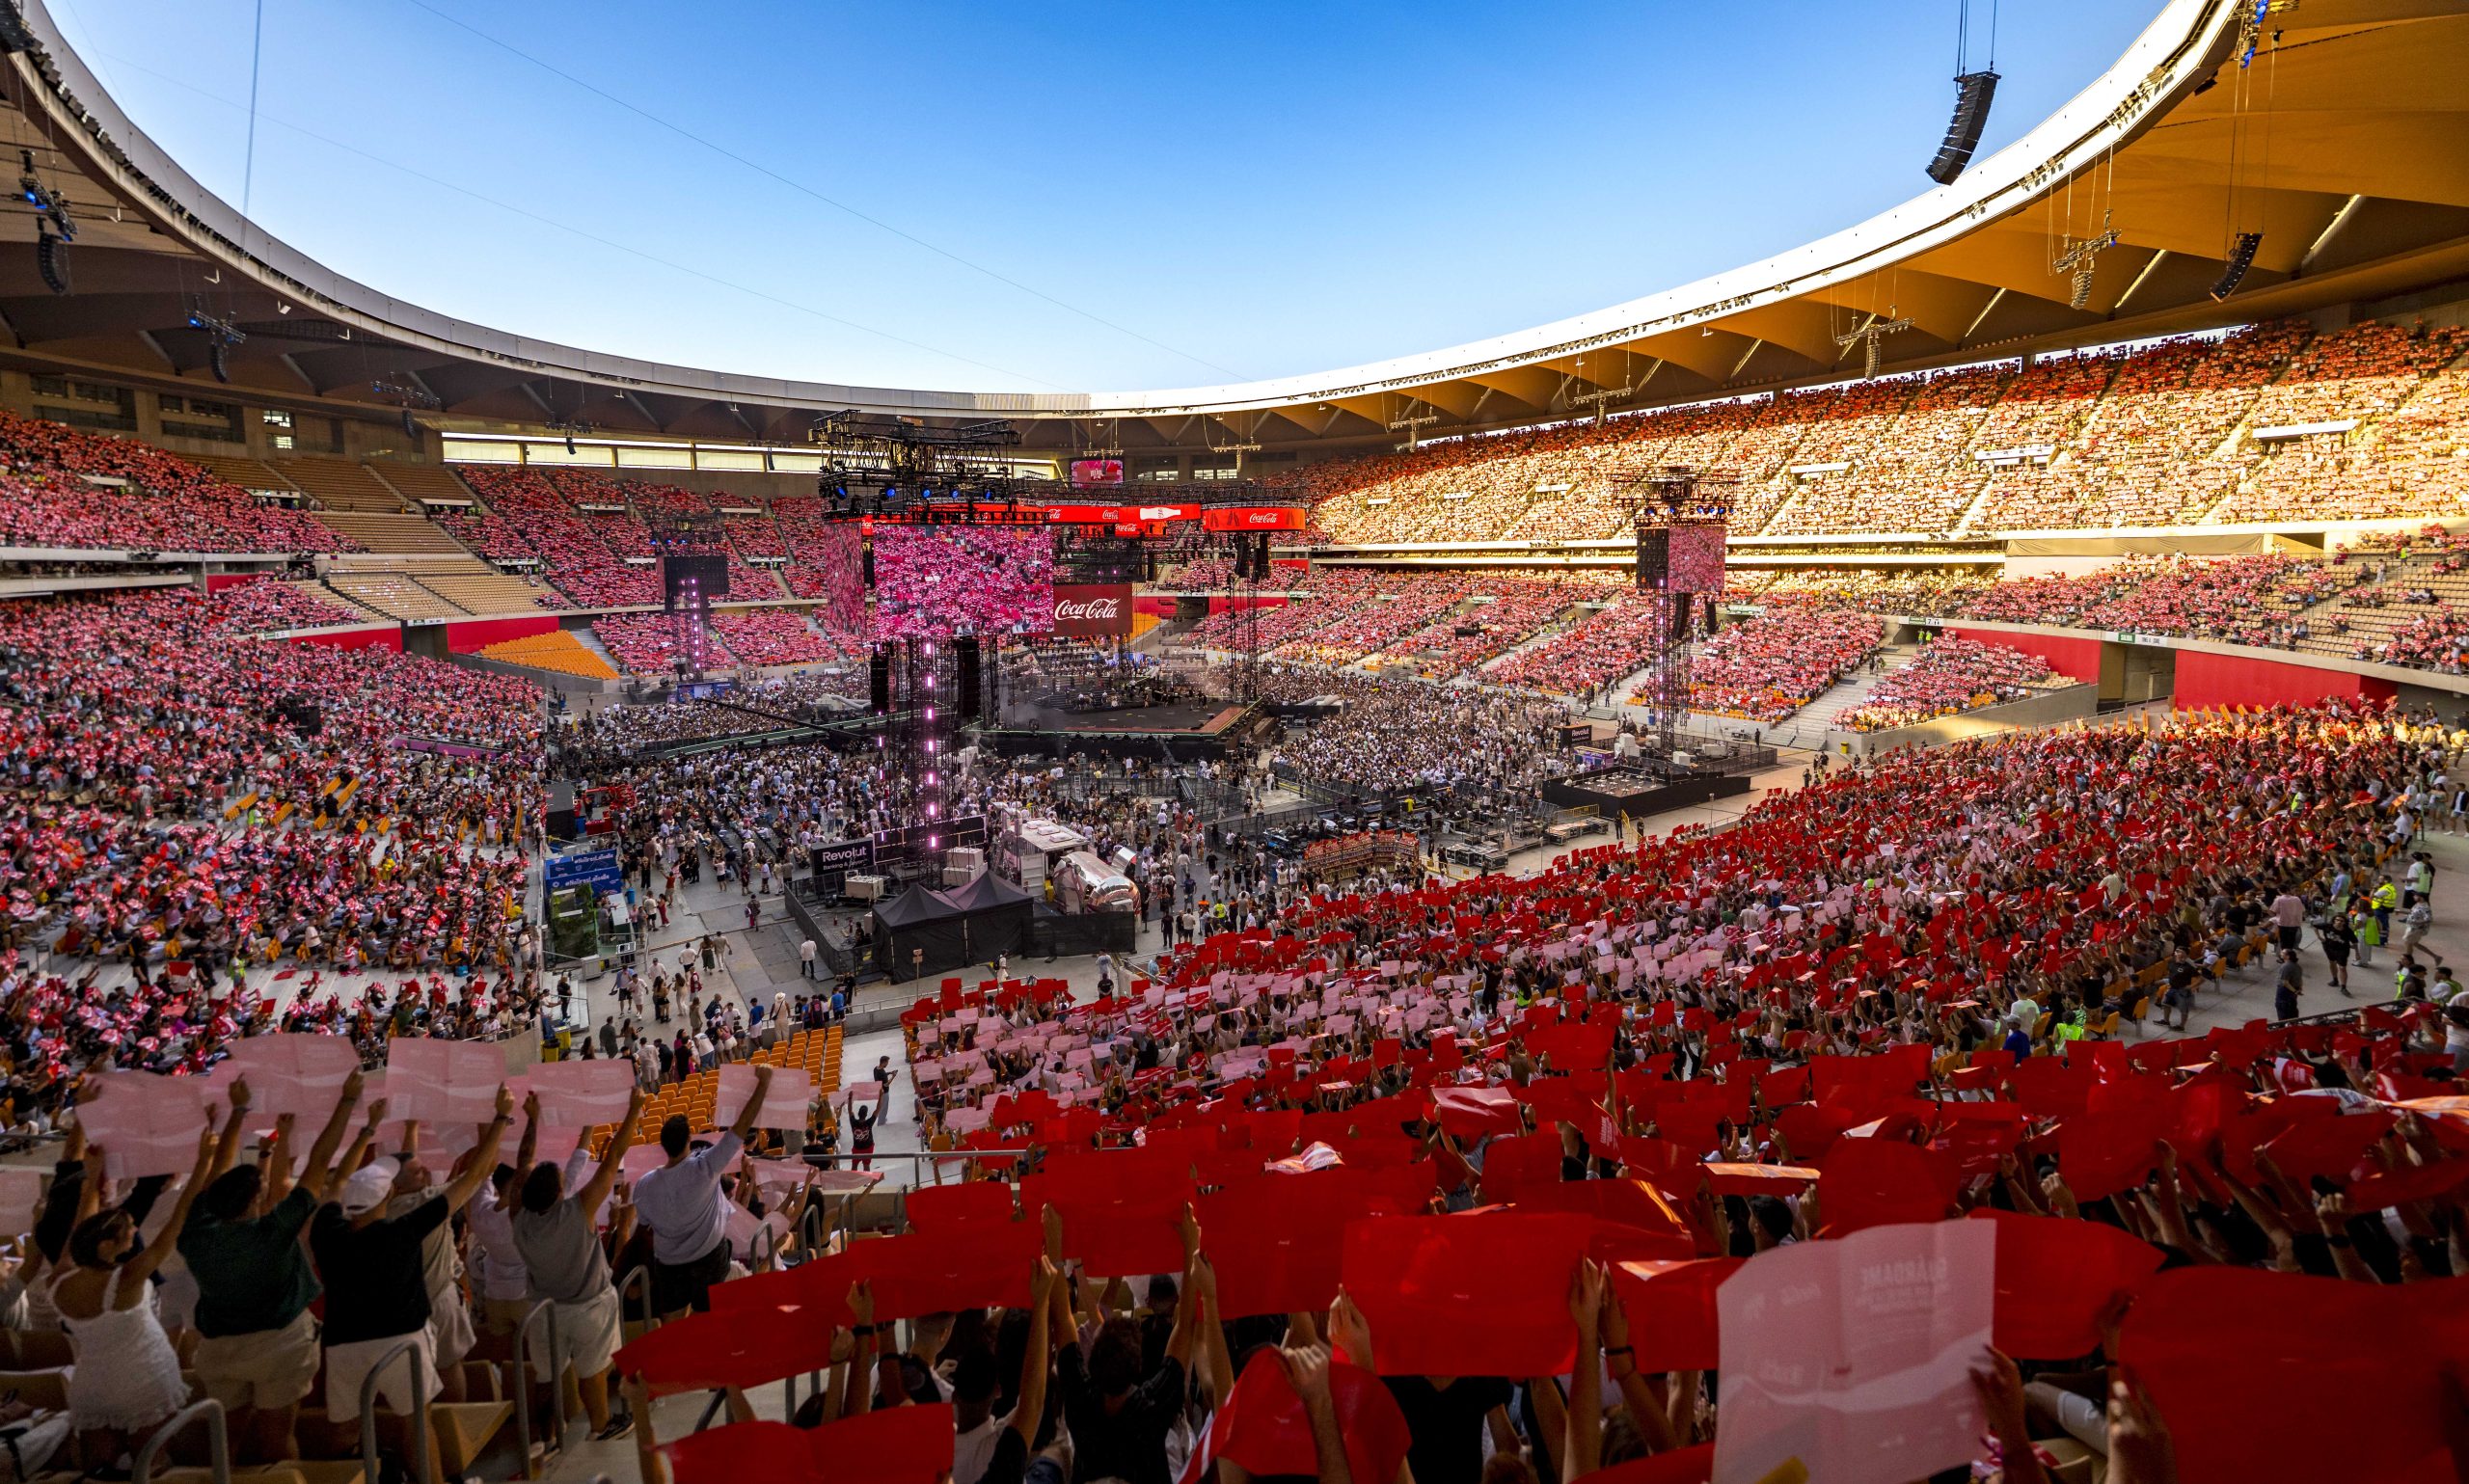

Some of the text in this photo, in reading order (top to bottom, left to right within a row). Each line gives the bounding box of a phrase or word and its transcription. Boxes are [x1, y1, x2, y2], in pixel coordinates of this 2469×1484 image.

[1249, 512, 1278, 524] Coca-Cola
[1054, 598, 1121, 621] Coca-Cola
[822, 846, 867, 863] Revolut
